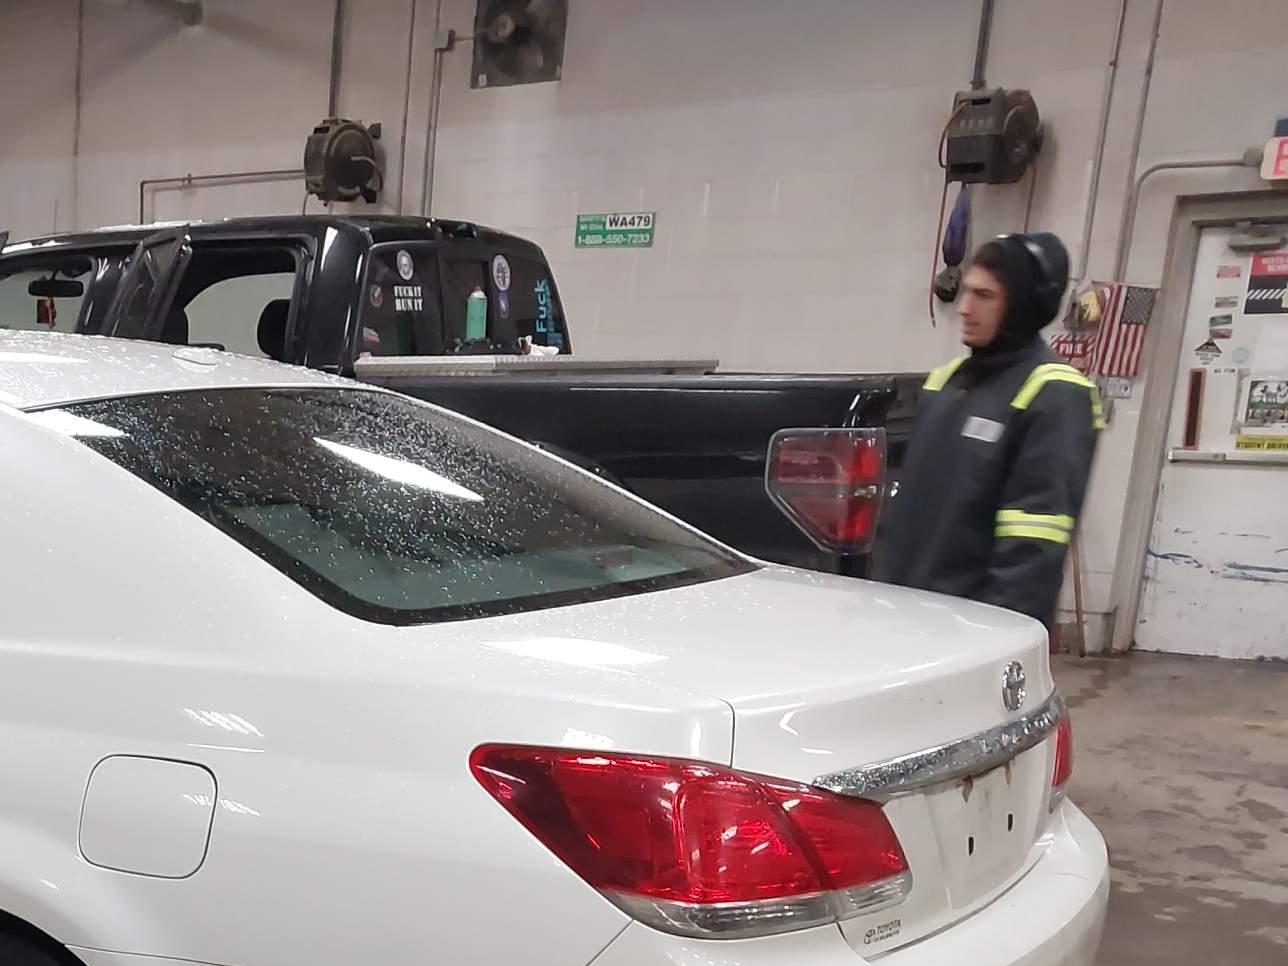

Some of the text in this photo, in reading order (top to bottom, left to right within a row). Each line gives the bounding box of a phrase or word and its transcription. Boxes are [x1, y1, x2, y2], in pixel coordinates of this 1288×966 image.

[608, 215, 651, 228] WA479
[393, 285, 422, 297] FUCK IT
[395, 298, 423, 311] RUN IT
[534, 279, 548, 333] Fuck
[1058, 343, 1084, 355] FIRE
